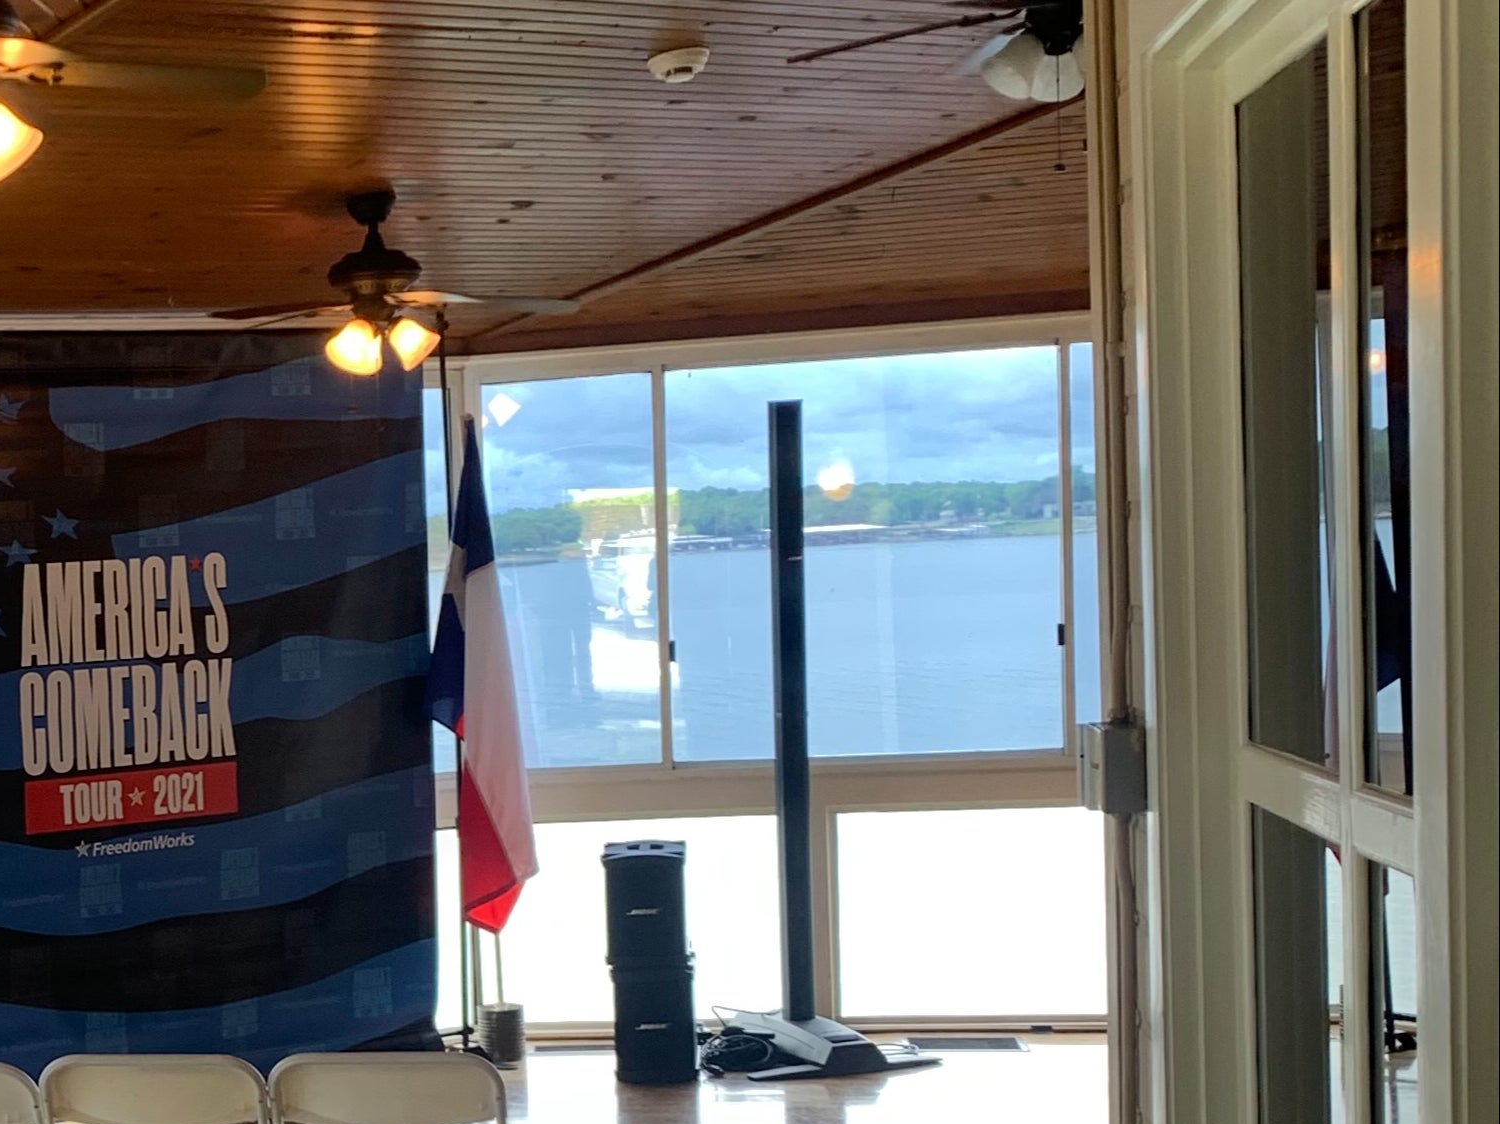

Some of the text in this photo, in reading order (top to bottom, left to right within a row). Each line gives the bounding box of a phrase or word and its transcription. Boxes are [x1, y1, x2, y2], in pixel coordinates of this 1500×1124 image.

[21, 552, 230, 668] AMERICA'S
[19, 657, 237, 777] COMEBACK
[59, 770, 205, 826] TOUR 2021
[92, 832, 196, 857] FreedomWorks
